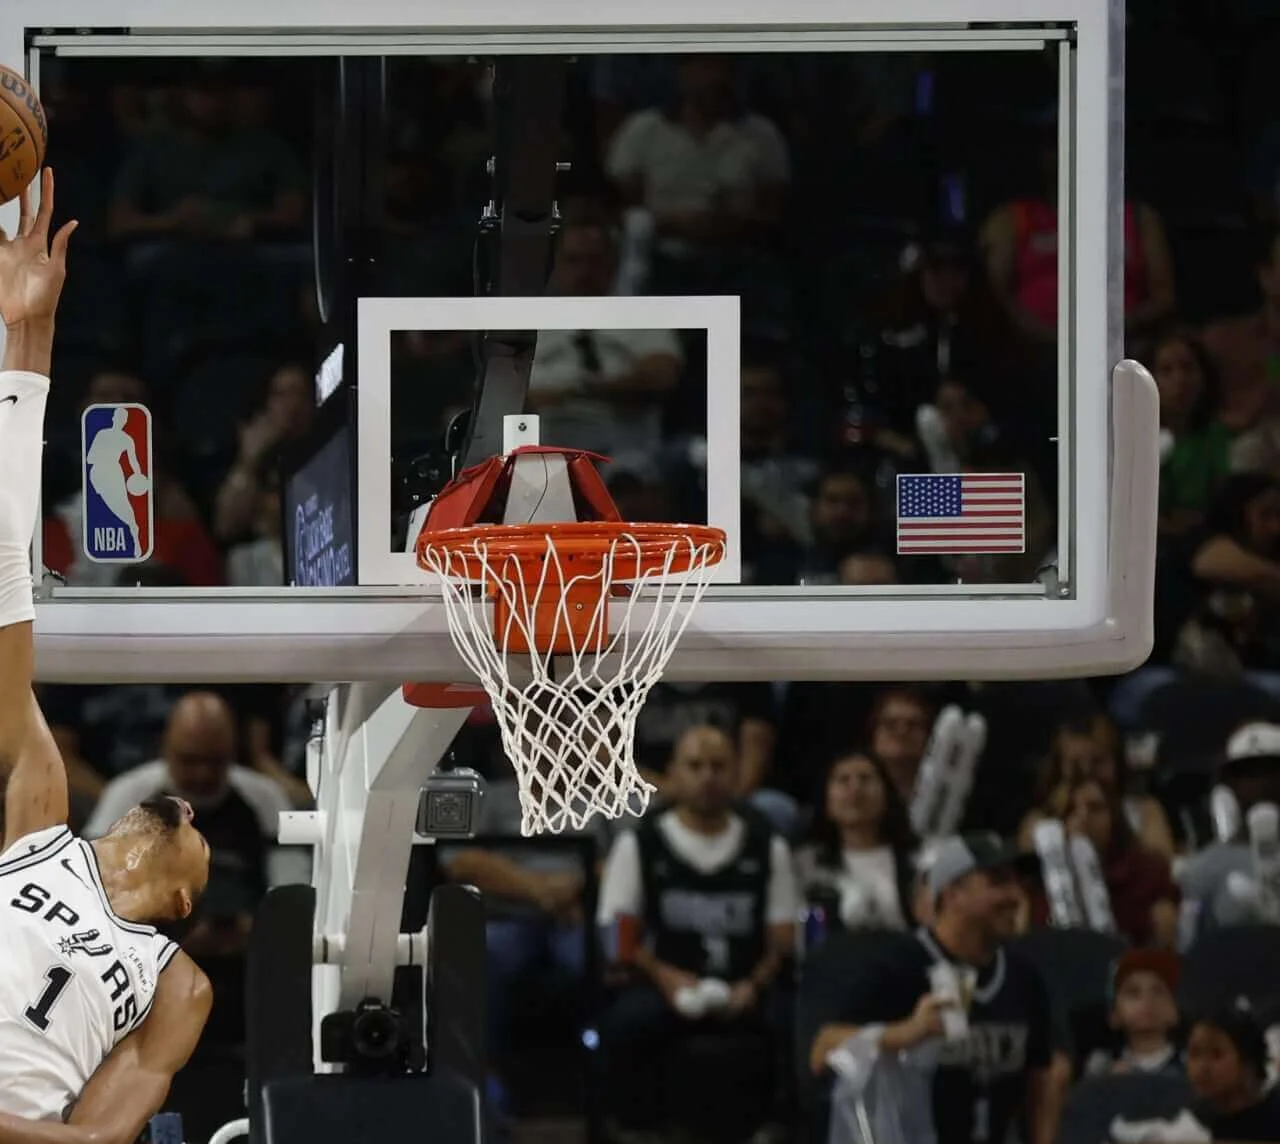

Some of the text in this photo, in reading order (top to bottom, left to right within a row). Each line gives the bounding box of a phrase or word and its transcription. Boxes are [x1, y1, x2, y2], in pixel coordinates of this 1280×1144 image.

[94, 527, 127, 552] NBA
[10, 882, 138, 1032] SPURS
[23, 963, 76, 1034] 1
